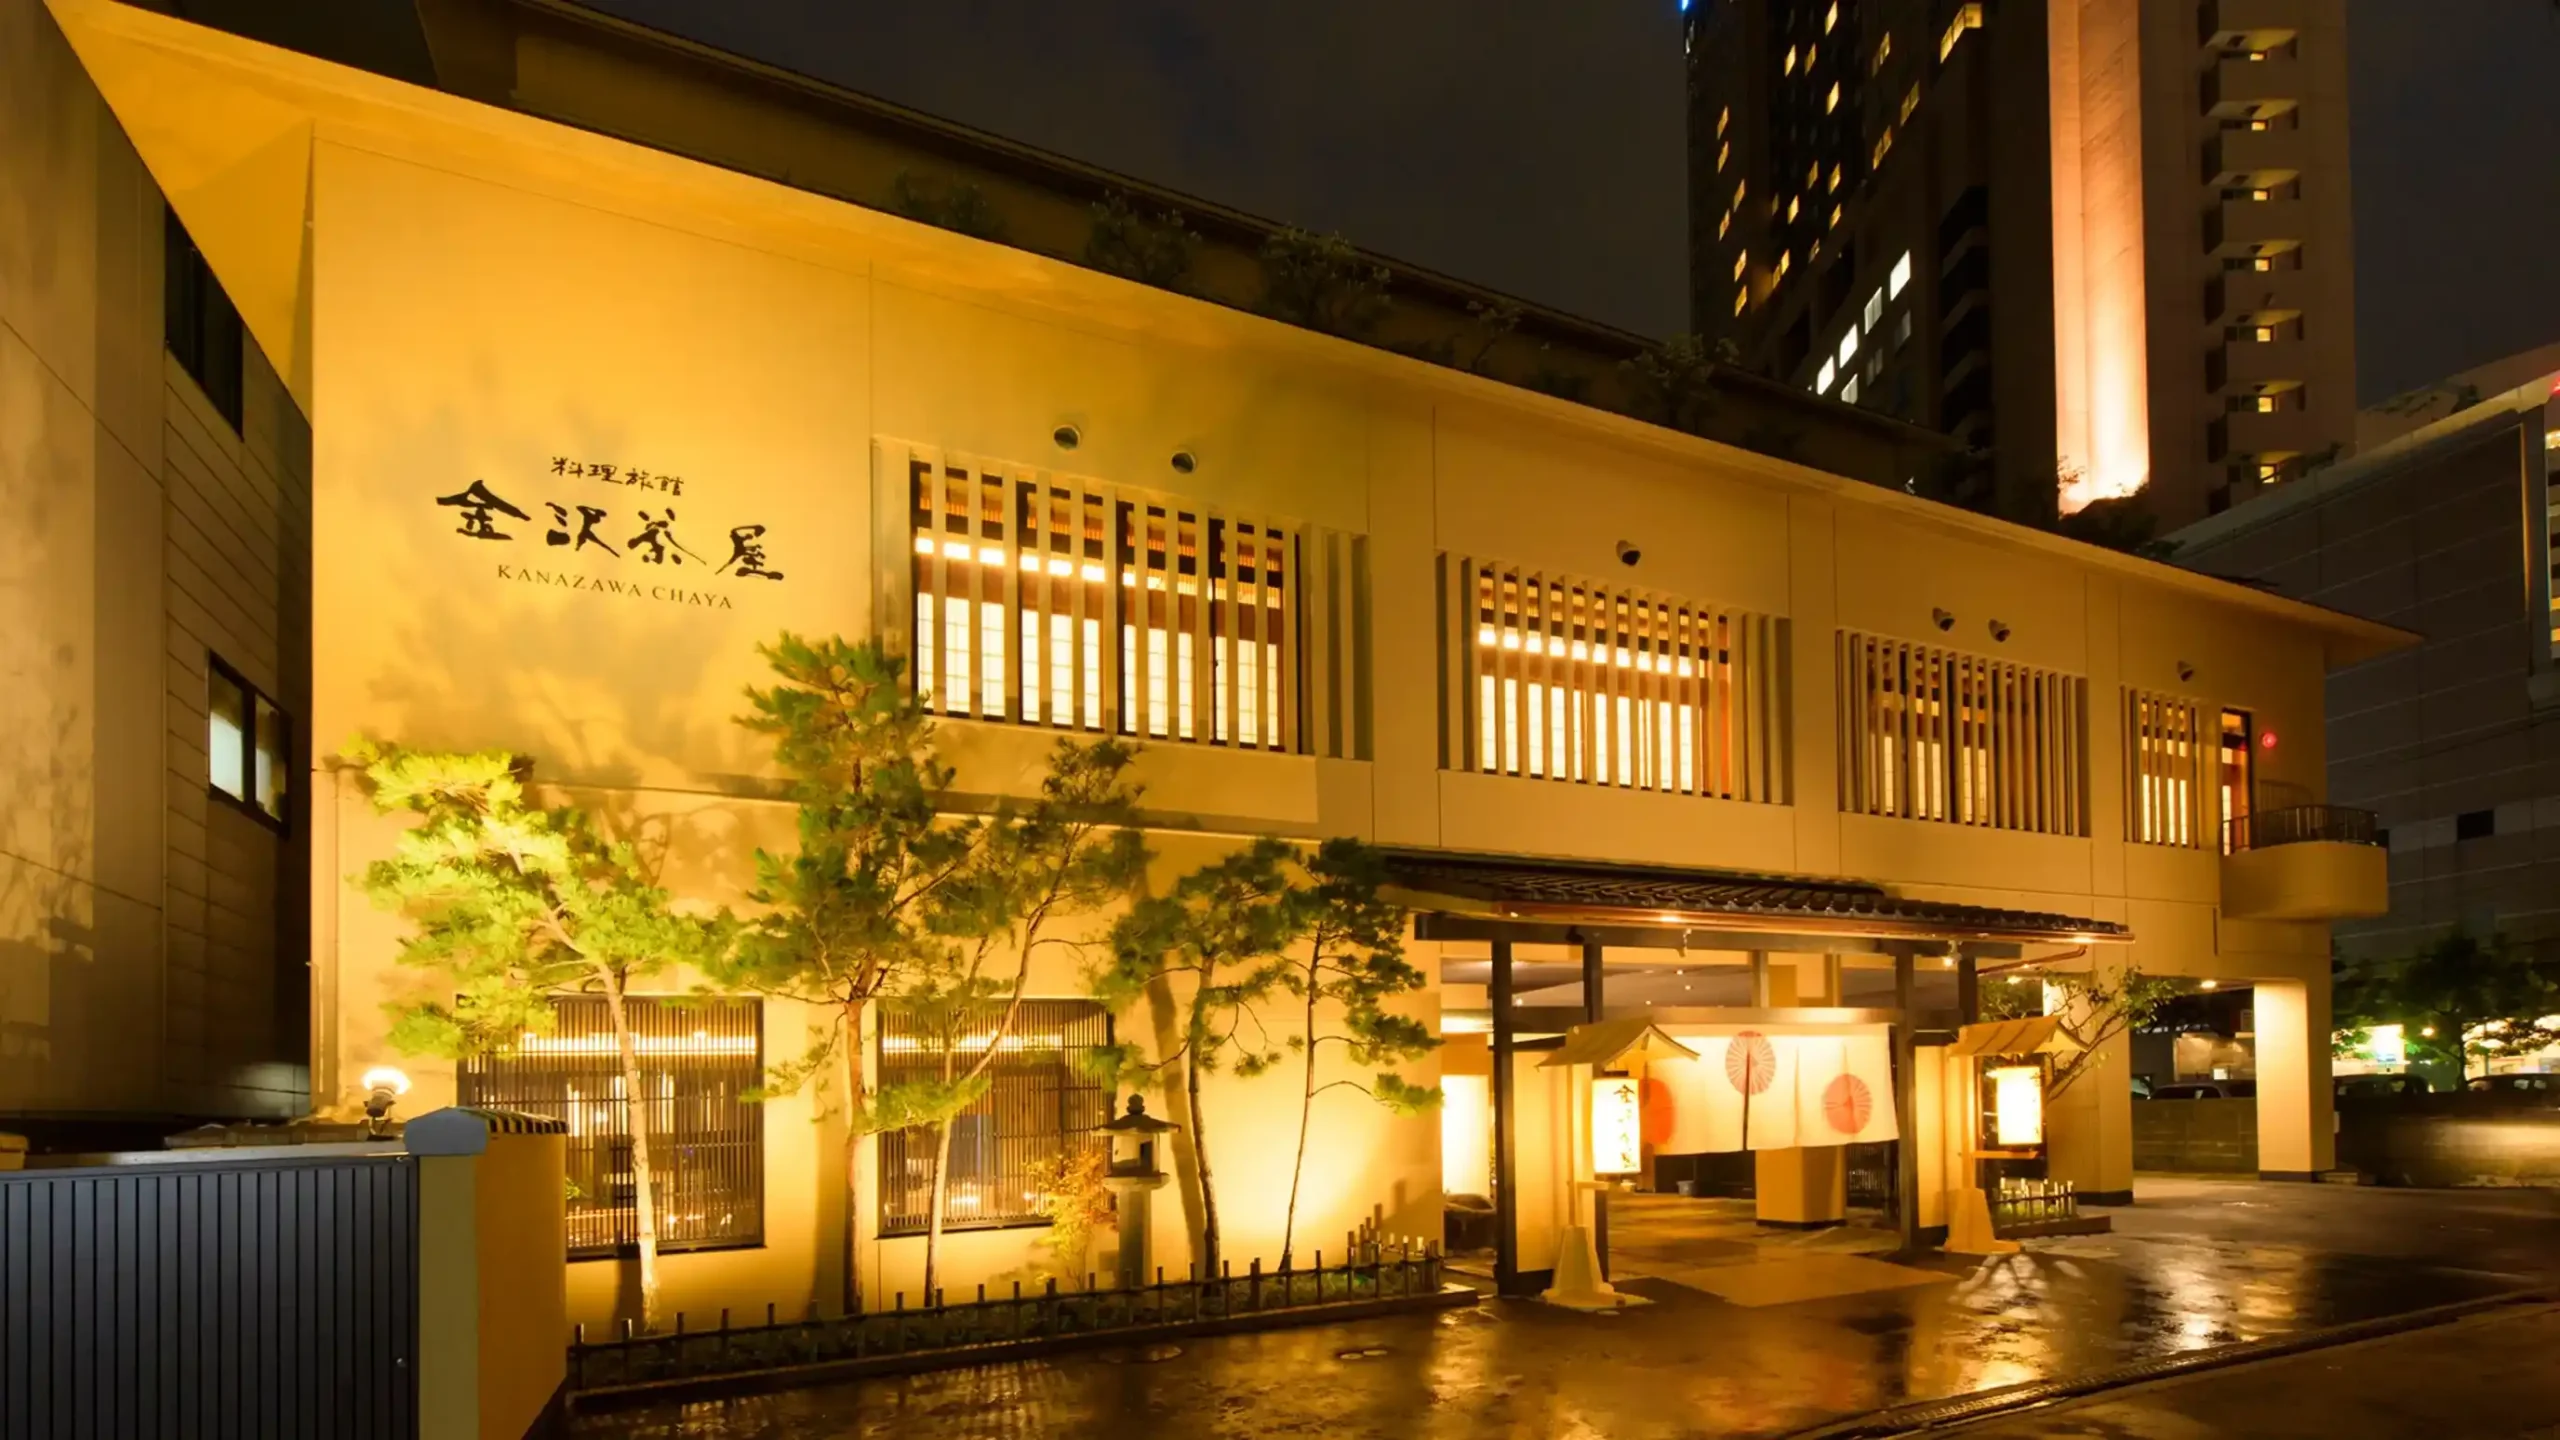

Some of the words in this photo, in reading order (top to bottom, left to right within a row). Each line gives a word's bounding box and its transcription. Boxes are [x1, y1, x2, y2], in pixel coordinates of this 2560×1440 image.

[550, 456, 684, 497] 料理旅館
[435, 479, 784, 581] 金沢茶屋
[498, 564, 642, 597] KANAZAWA
[652, 586, 732, 610] CHAYA
